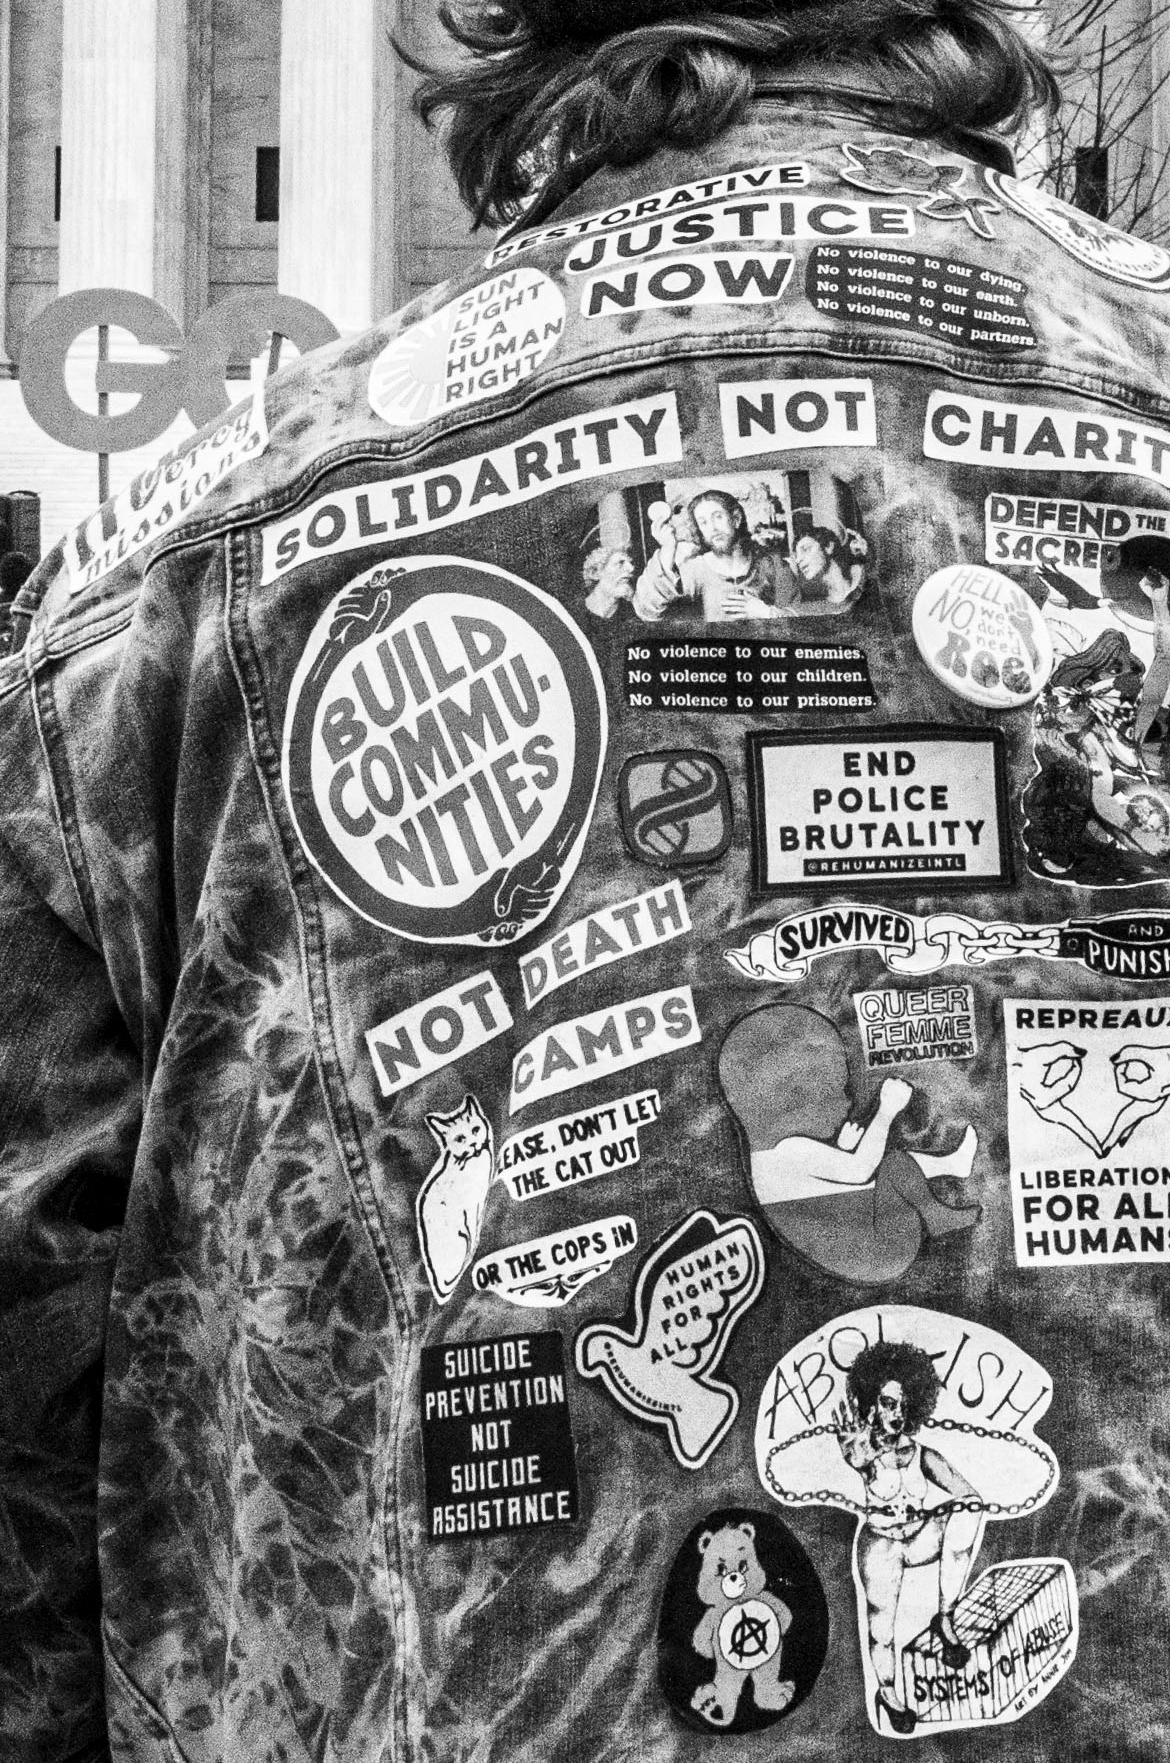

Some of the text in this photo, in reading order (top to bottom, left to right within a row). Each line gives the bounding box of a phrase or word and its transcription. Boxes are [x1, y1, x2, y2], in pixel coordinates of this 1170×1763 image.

[491, 163, 806, 264] RESTORATIVE
[566, 201, 910, 273] JUSTICE
[460, 272, 519, 312] SUN
[588, 256, 795, 317] NOW
[817, 246, 1026, 294] No violence to our dying.
[817, 264, 1018, 307] No violence to our earth.
[453, 281, 546, 333] LIGHT
[817, 281, 1030, 328] No violence to our unborn.
[817, 298, 1037, 347] No violence to our partners.
[446, 317, 564, 378] HUMAN
[449, 319, 508, 351] IS A
[445, 348, 544, 404] RIGHT
[737, 390, 867, 439] NOT
[275, 408, 668, 570] SOLIDARITY
[990, 496, 1167, 538] DEFEND THE
[951, 568, 1004, 605] HELL
[981, 606, 1006, 624] we
[627, 644, 866, 660] No violence to our enemies.
[977, 634, 1022, 656] need
[320, 614, 508, 766] BUILD
[628, 669, 867, 684] No violence to our children.
[629, 693, 877, 709] No violence to our prisoners.
[843, 750, 917, 778] END
[374, 734, 560, 888] NITIES
[812, 785, 950, 815] POLICE
[779, 819, 986, 853] BRUTALITY
[522, 888, 685, 1000] DEATH
[779, 909, 912, 961] SURVIVED
[1128, 923, 1166, 938] AND
[859, 988, 971, 1024] QUEER
[373, 980, 500, 1086] NOT
[513, 996, 693, 1095] CAMPS
[866, 1016, 972, 1049] FEMME
[868, 1040, 975, 1067] REVOLUTION
[499, 1094, 660, 1174] EASE, DON'T LET
[512, 1135, 638, 1198] THE CAT OUT
[1023, 1194, 1100, 1224] FOR
[476, 1220, 636, 1289] OR THE COPS IN
[665, 1240, 742, 1284] HUMAN
[661, 1265, 742, 1310] RIGHTS
[659, 1304, 704, 1336] FOR
[444, 1339, 532, 1379] SUICIDE
[650, 1337, 688, 1366] ALL
[425, 1375, 565, 1420] PREVENTION
[471, 1420, 511, 1453] NOT
[450, 1455, 541, 1493] SUICIDE
[432, 1490, 571, 1536] ASSISTANCE
[914, 1670, 990, 1703] SYSTEMS
[1000, 1648, 1019, 1678] OF
[1024, 1611, 1066, 1660] ABUSE
